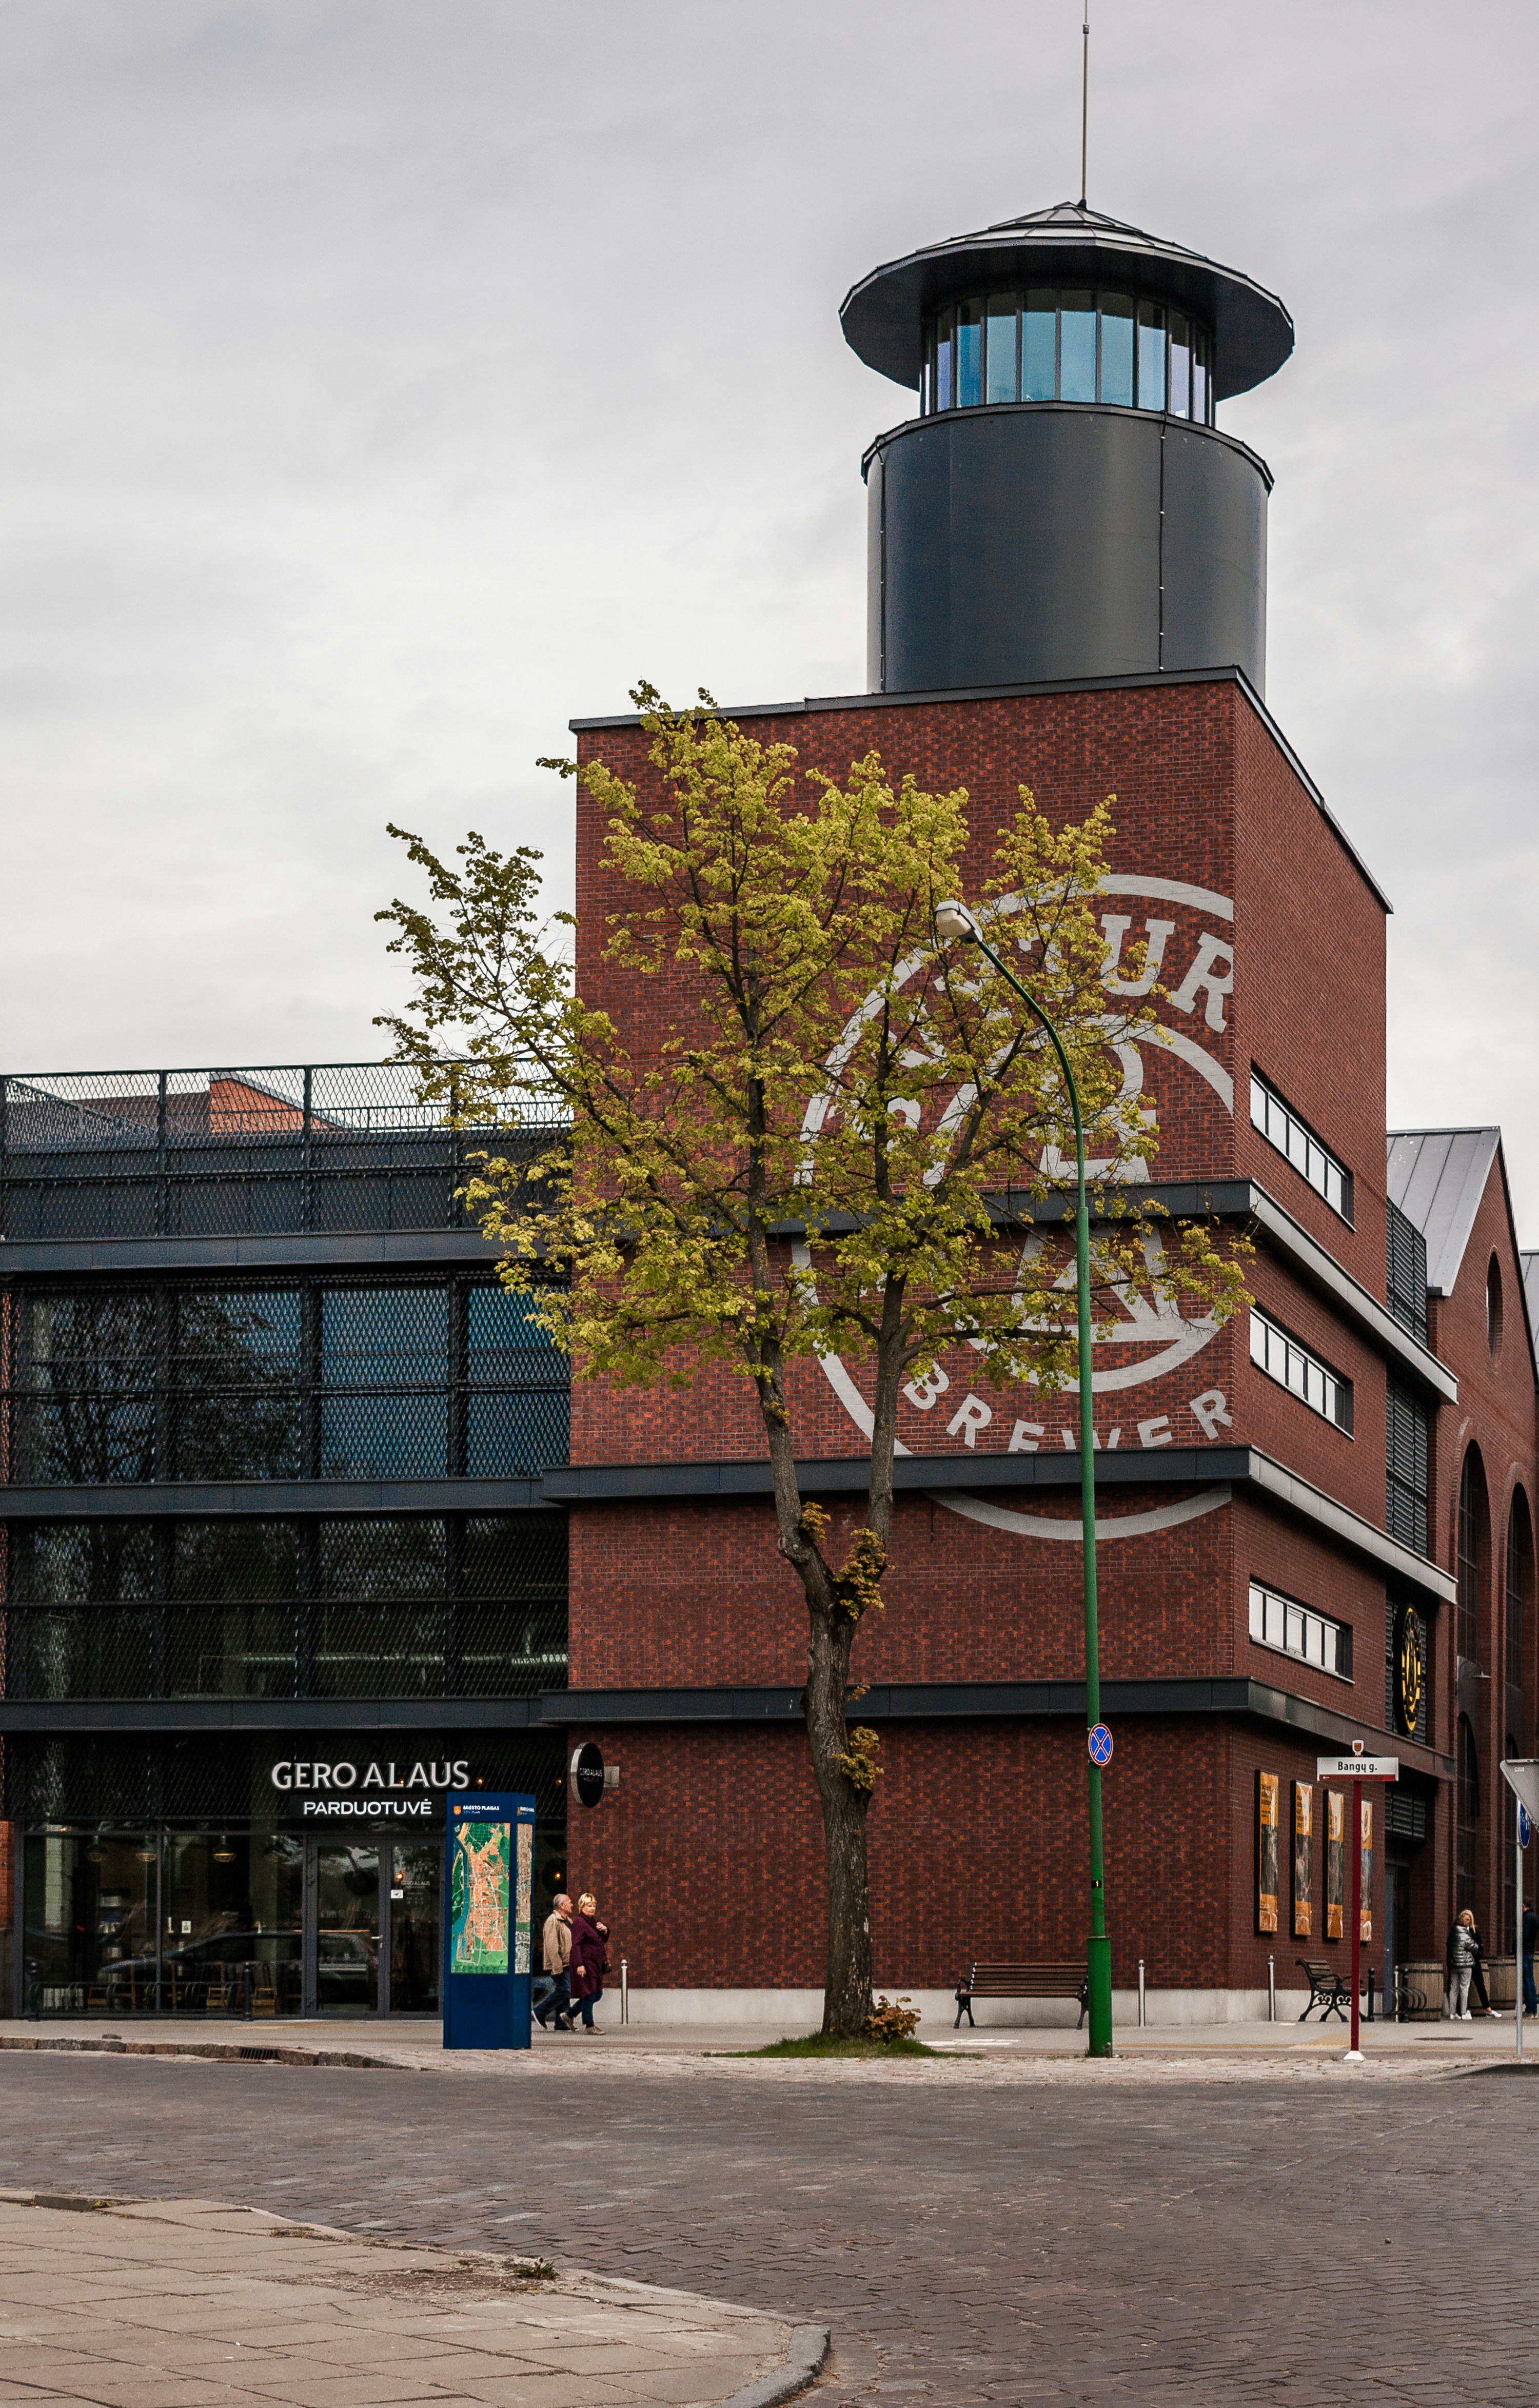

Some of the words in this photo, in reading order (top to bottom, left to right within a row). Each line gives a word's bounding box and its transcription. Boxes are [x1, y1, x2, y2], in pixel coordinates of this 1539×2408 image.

[271, 1761, 357, 1789] GERO
[360, 1761, 469, 1789] ALAUS
[1337, 1761, 1366, 1773] Bangų
[1369, 1763, 1378, 1773] g.
[303, 1798, 432, 1815] PARDUOTUVĖ
